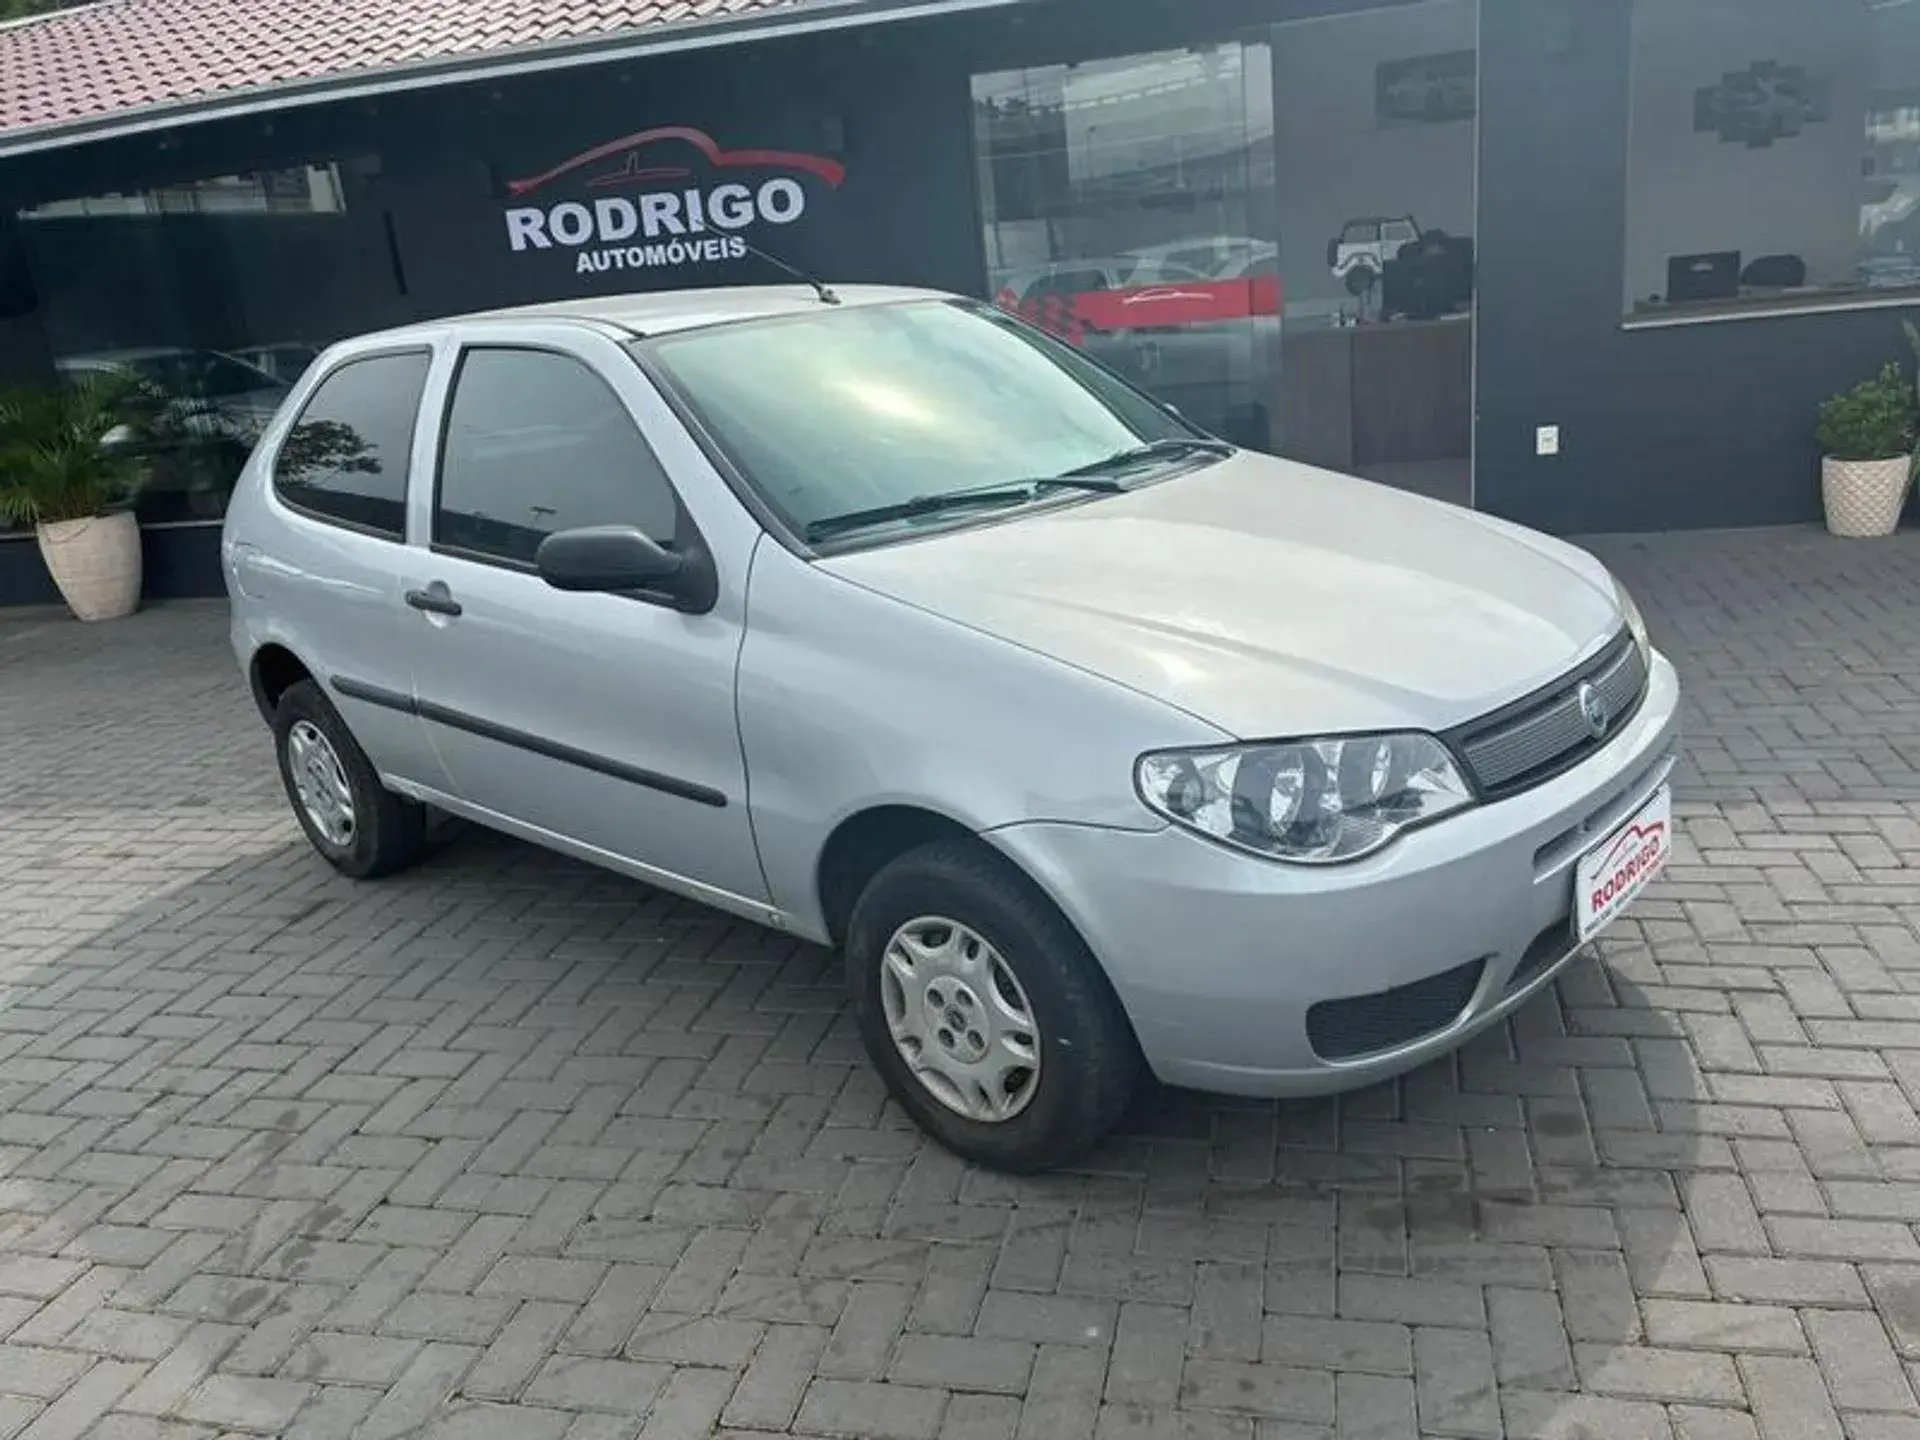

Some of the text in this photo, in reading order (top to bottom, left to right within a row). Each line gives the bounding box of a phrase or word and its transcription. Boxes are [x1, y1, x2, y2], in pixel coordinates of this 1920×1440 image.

[505, 178, 804, 250] RODRIGO
[576, 236, 747, 273] AUTOMÓVEIS
[1591, 836, 1660, 912] RODRIGO
